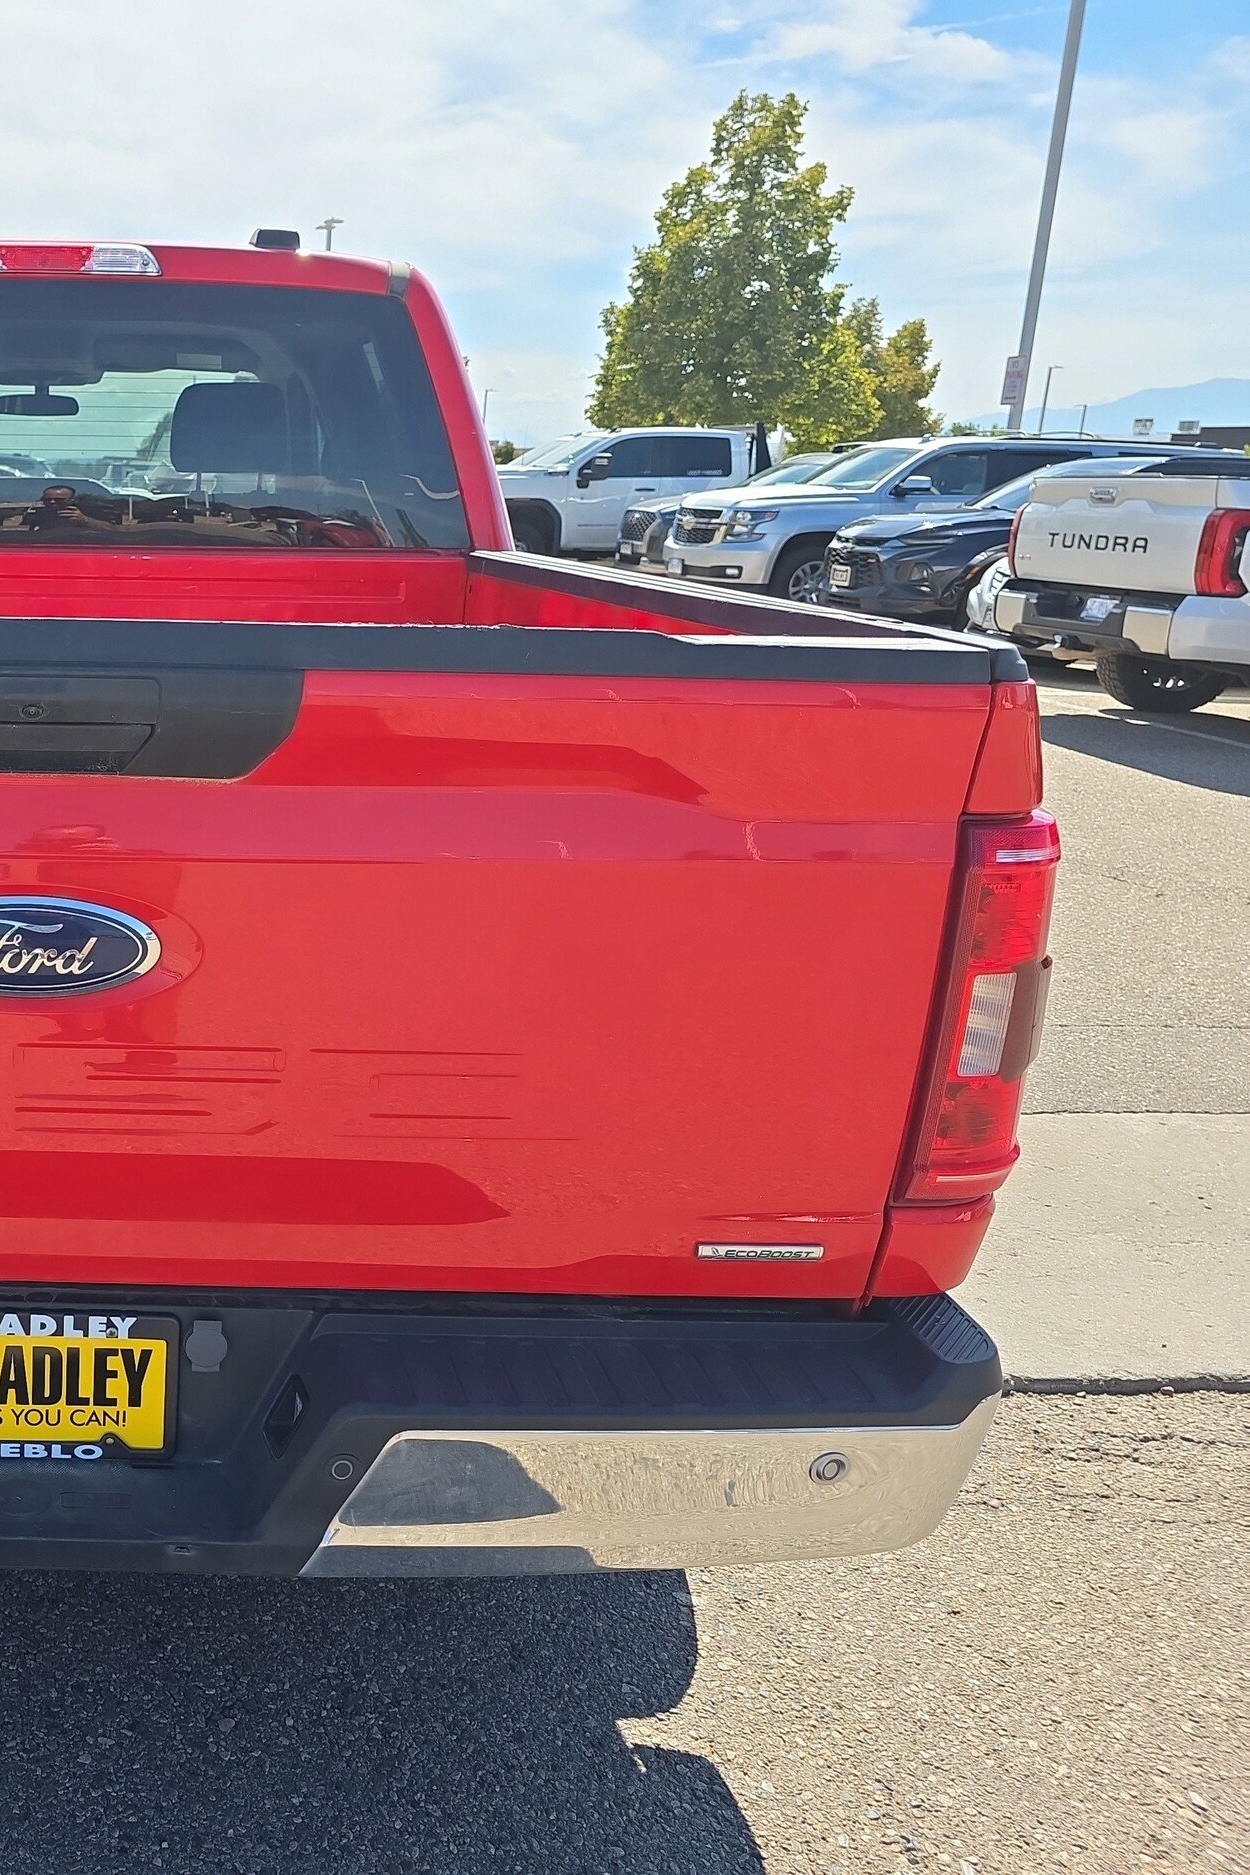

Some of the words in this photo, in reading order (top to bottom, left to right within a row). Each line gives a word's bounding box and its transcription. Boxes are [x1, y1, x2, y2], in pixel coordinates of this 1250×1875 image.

[1048, 532, 1149, 554] TUNDRA
[13, 1408, 61, 1427] YOU
[69, 1409, 127, 1428] CAN!
